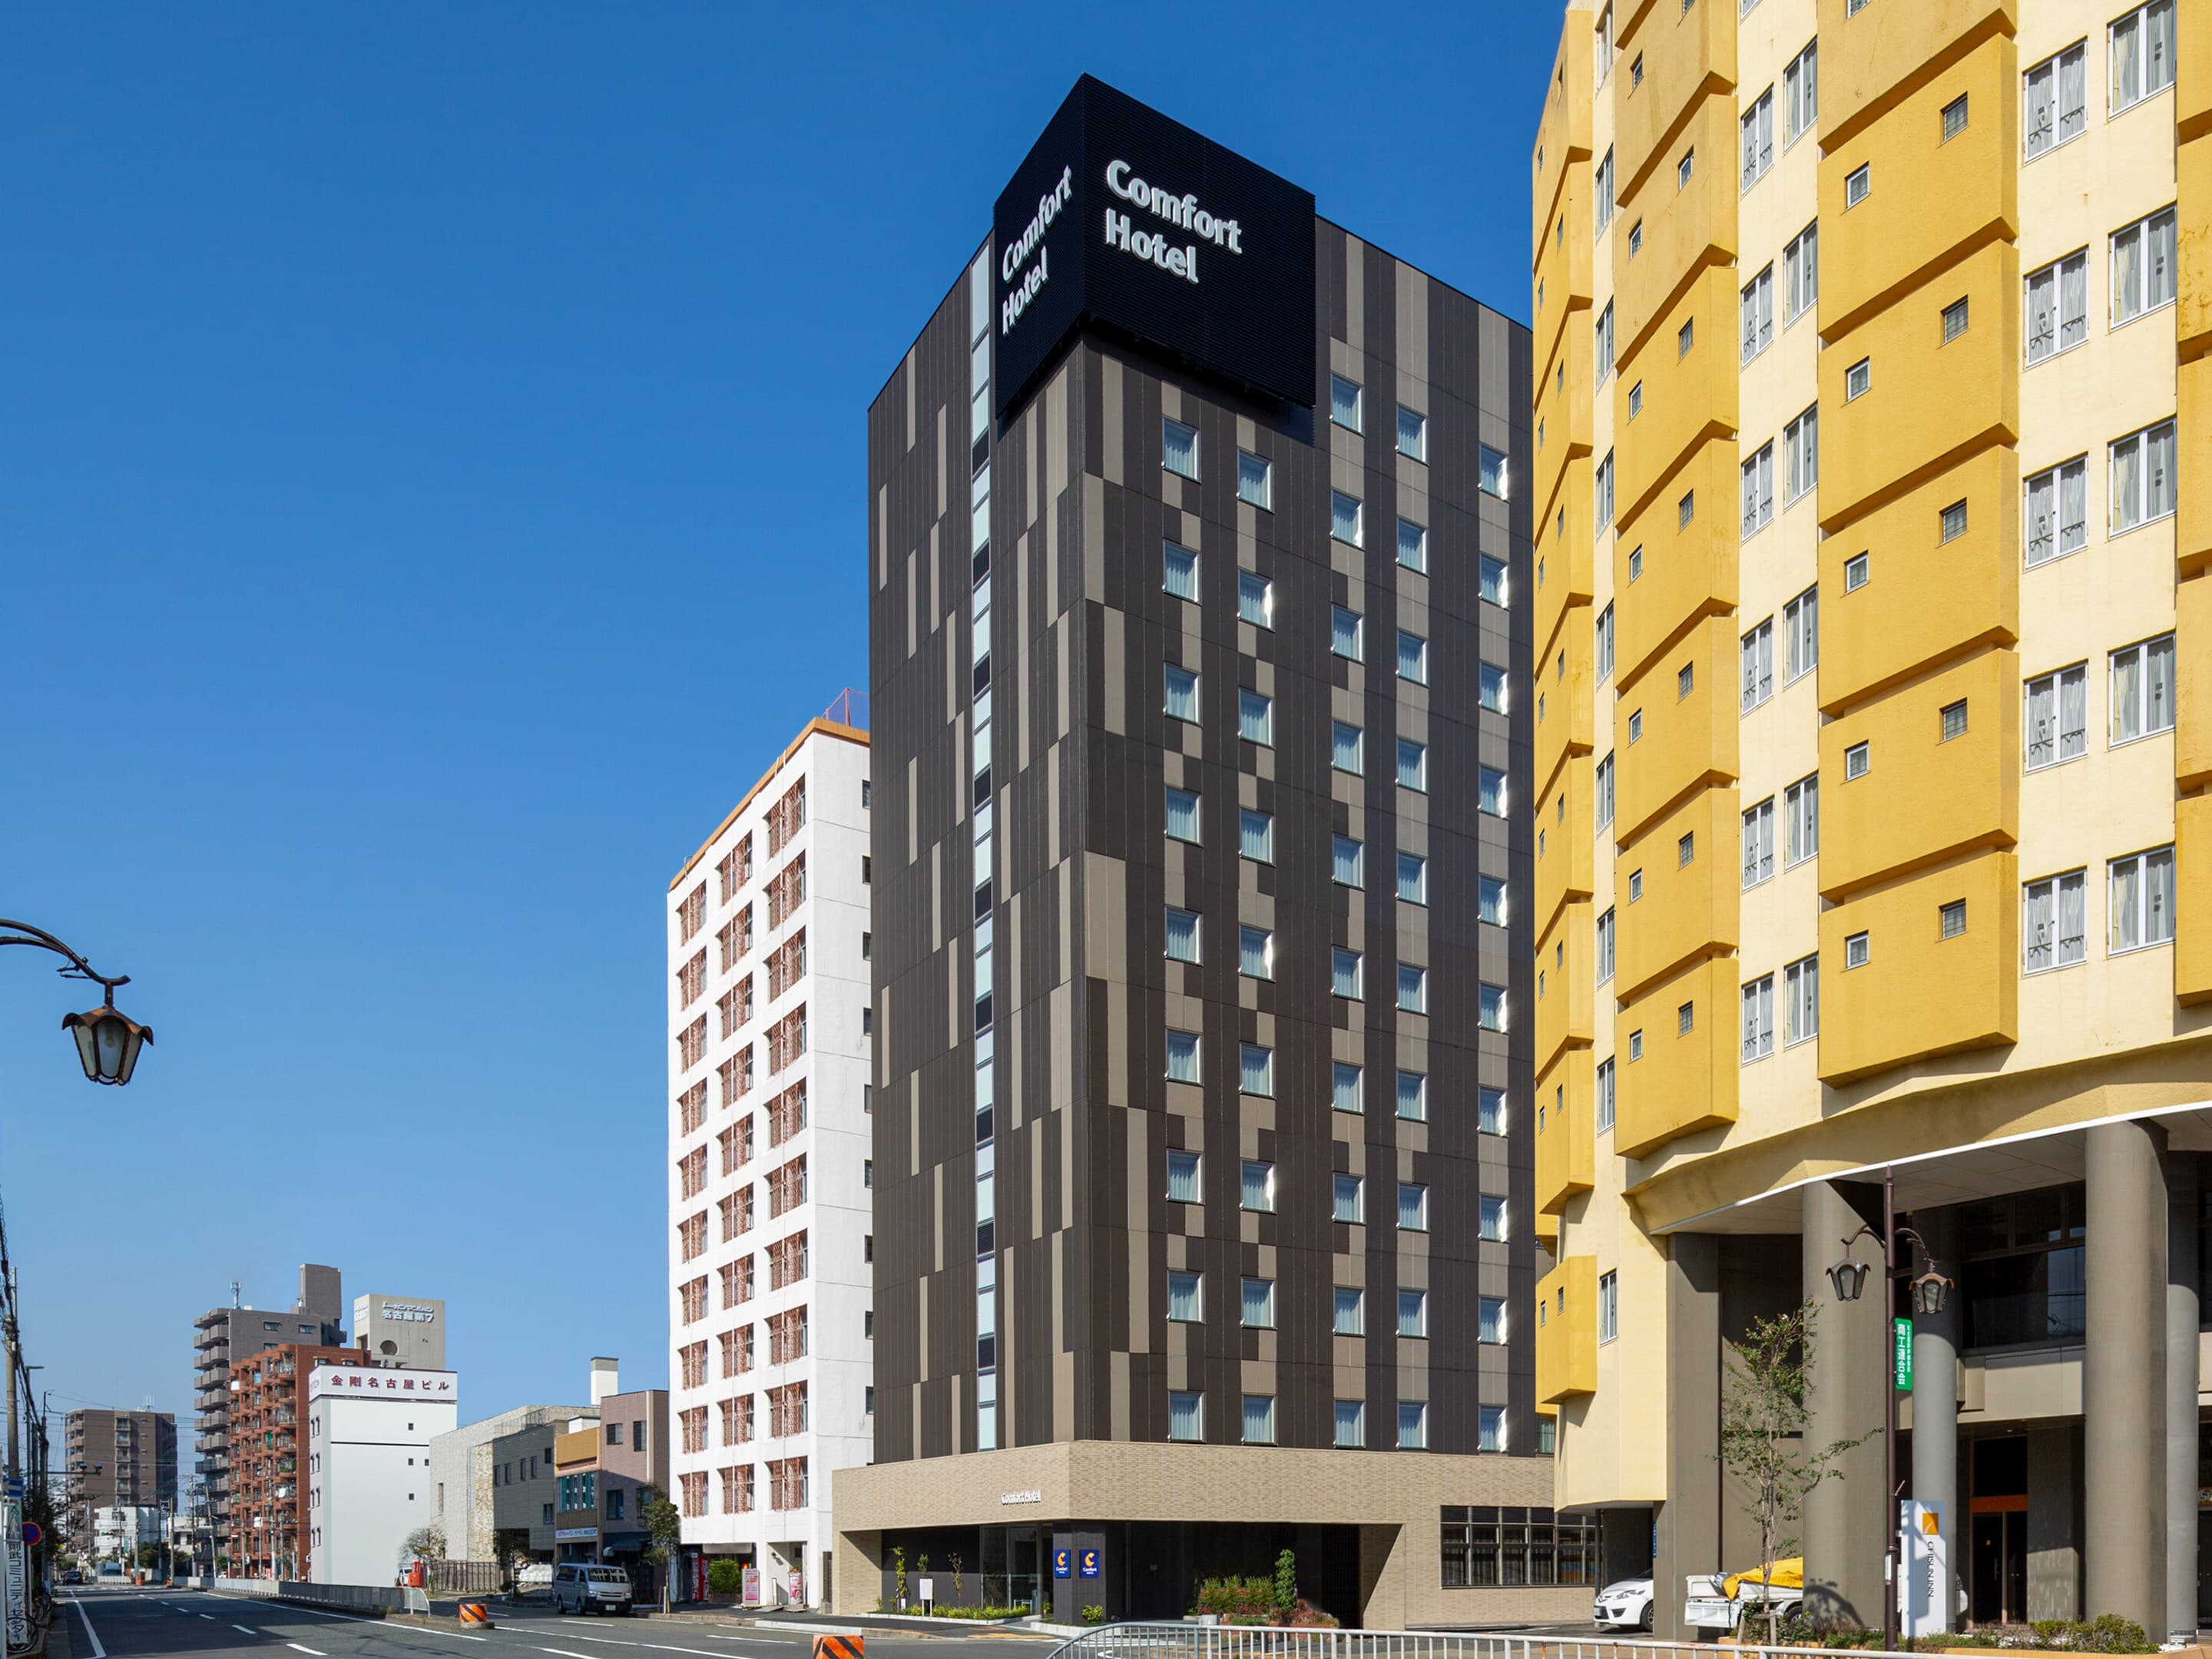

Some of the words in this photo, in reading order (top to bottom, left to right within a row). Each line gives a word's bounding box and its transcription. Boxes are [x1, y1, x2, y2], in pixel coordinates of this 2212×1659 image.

[1002, 164, 1072, 283] Comfort
[1106, 208, 1199, 283] Hotel
[1107, 160, 1243, 254] Comfort
[1002, 246, 1048, 336] Hotel
[331, 1375, 449, 1390] 金剛名古屋ビル
